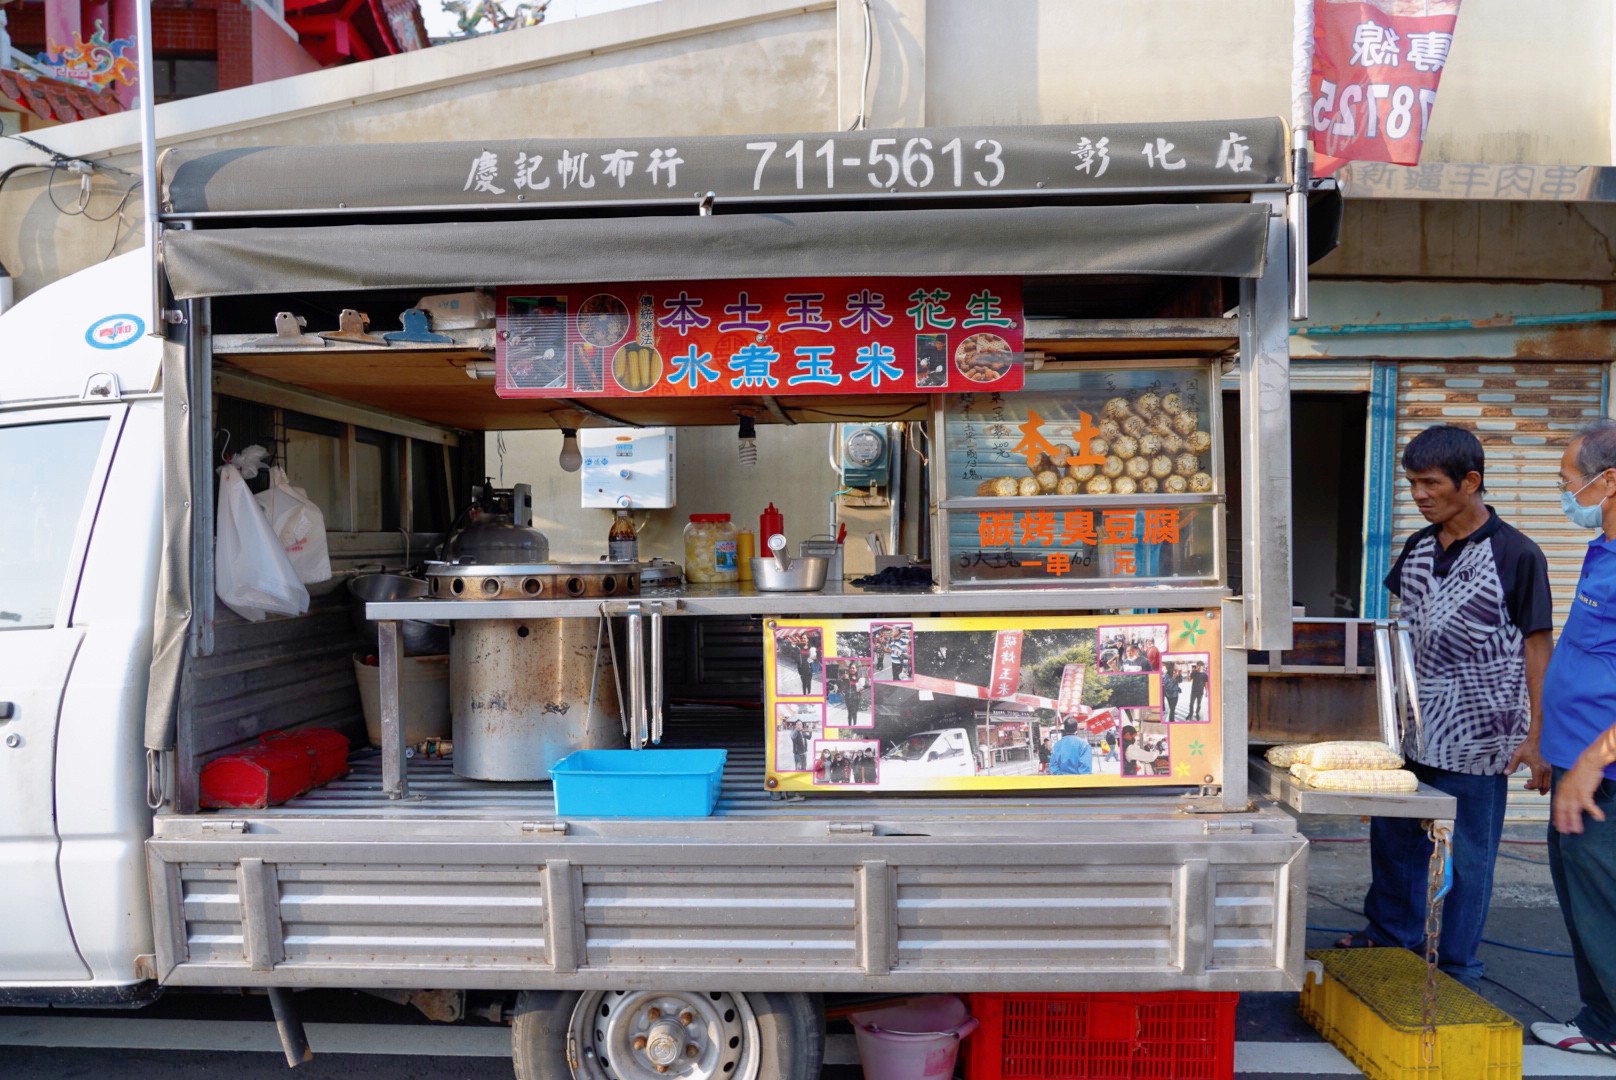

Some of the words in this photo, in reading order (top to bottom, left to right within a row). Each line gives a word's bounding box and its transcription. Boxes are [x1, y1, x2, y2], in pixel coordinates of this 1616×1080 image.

[463, 148, 685, 195] 慶記帆布行
[746, 138, 1005, 190] 711-5613
[1071, 132, 1253, 178] 彰化店
[640, 295, 655, 346] 傳統烤法
[667, 344, 904, 387] 水煮玉米
[1011, 410, 1107, 466] 本土
[977, 508, 1181, 548] 碳烤臭豆腐
[1021, 552, 1071, 577] 一串
[1113, 552, 1137, 575] 元
